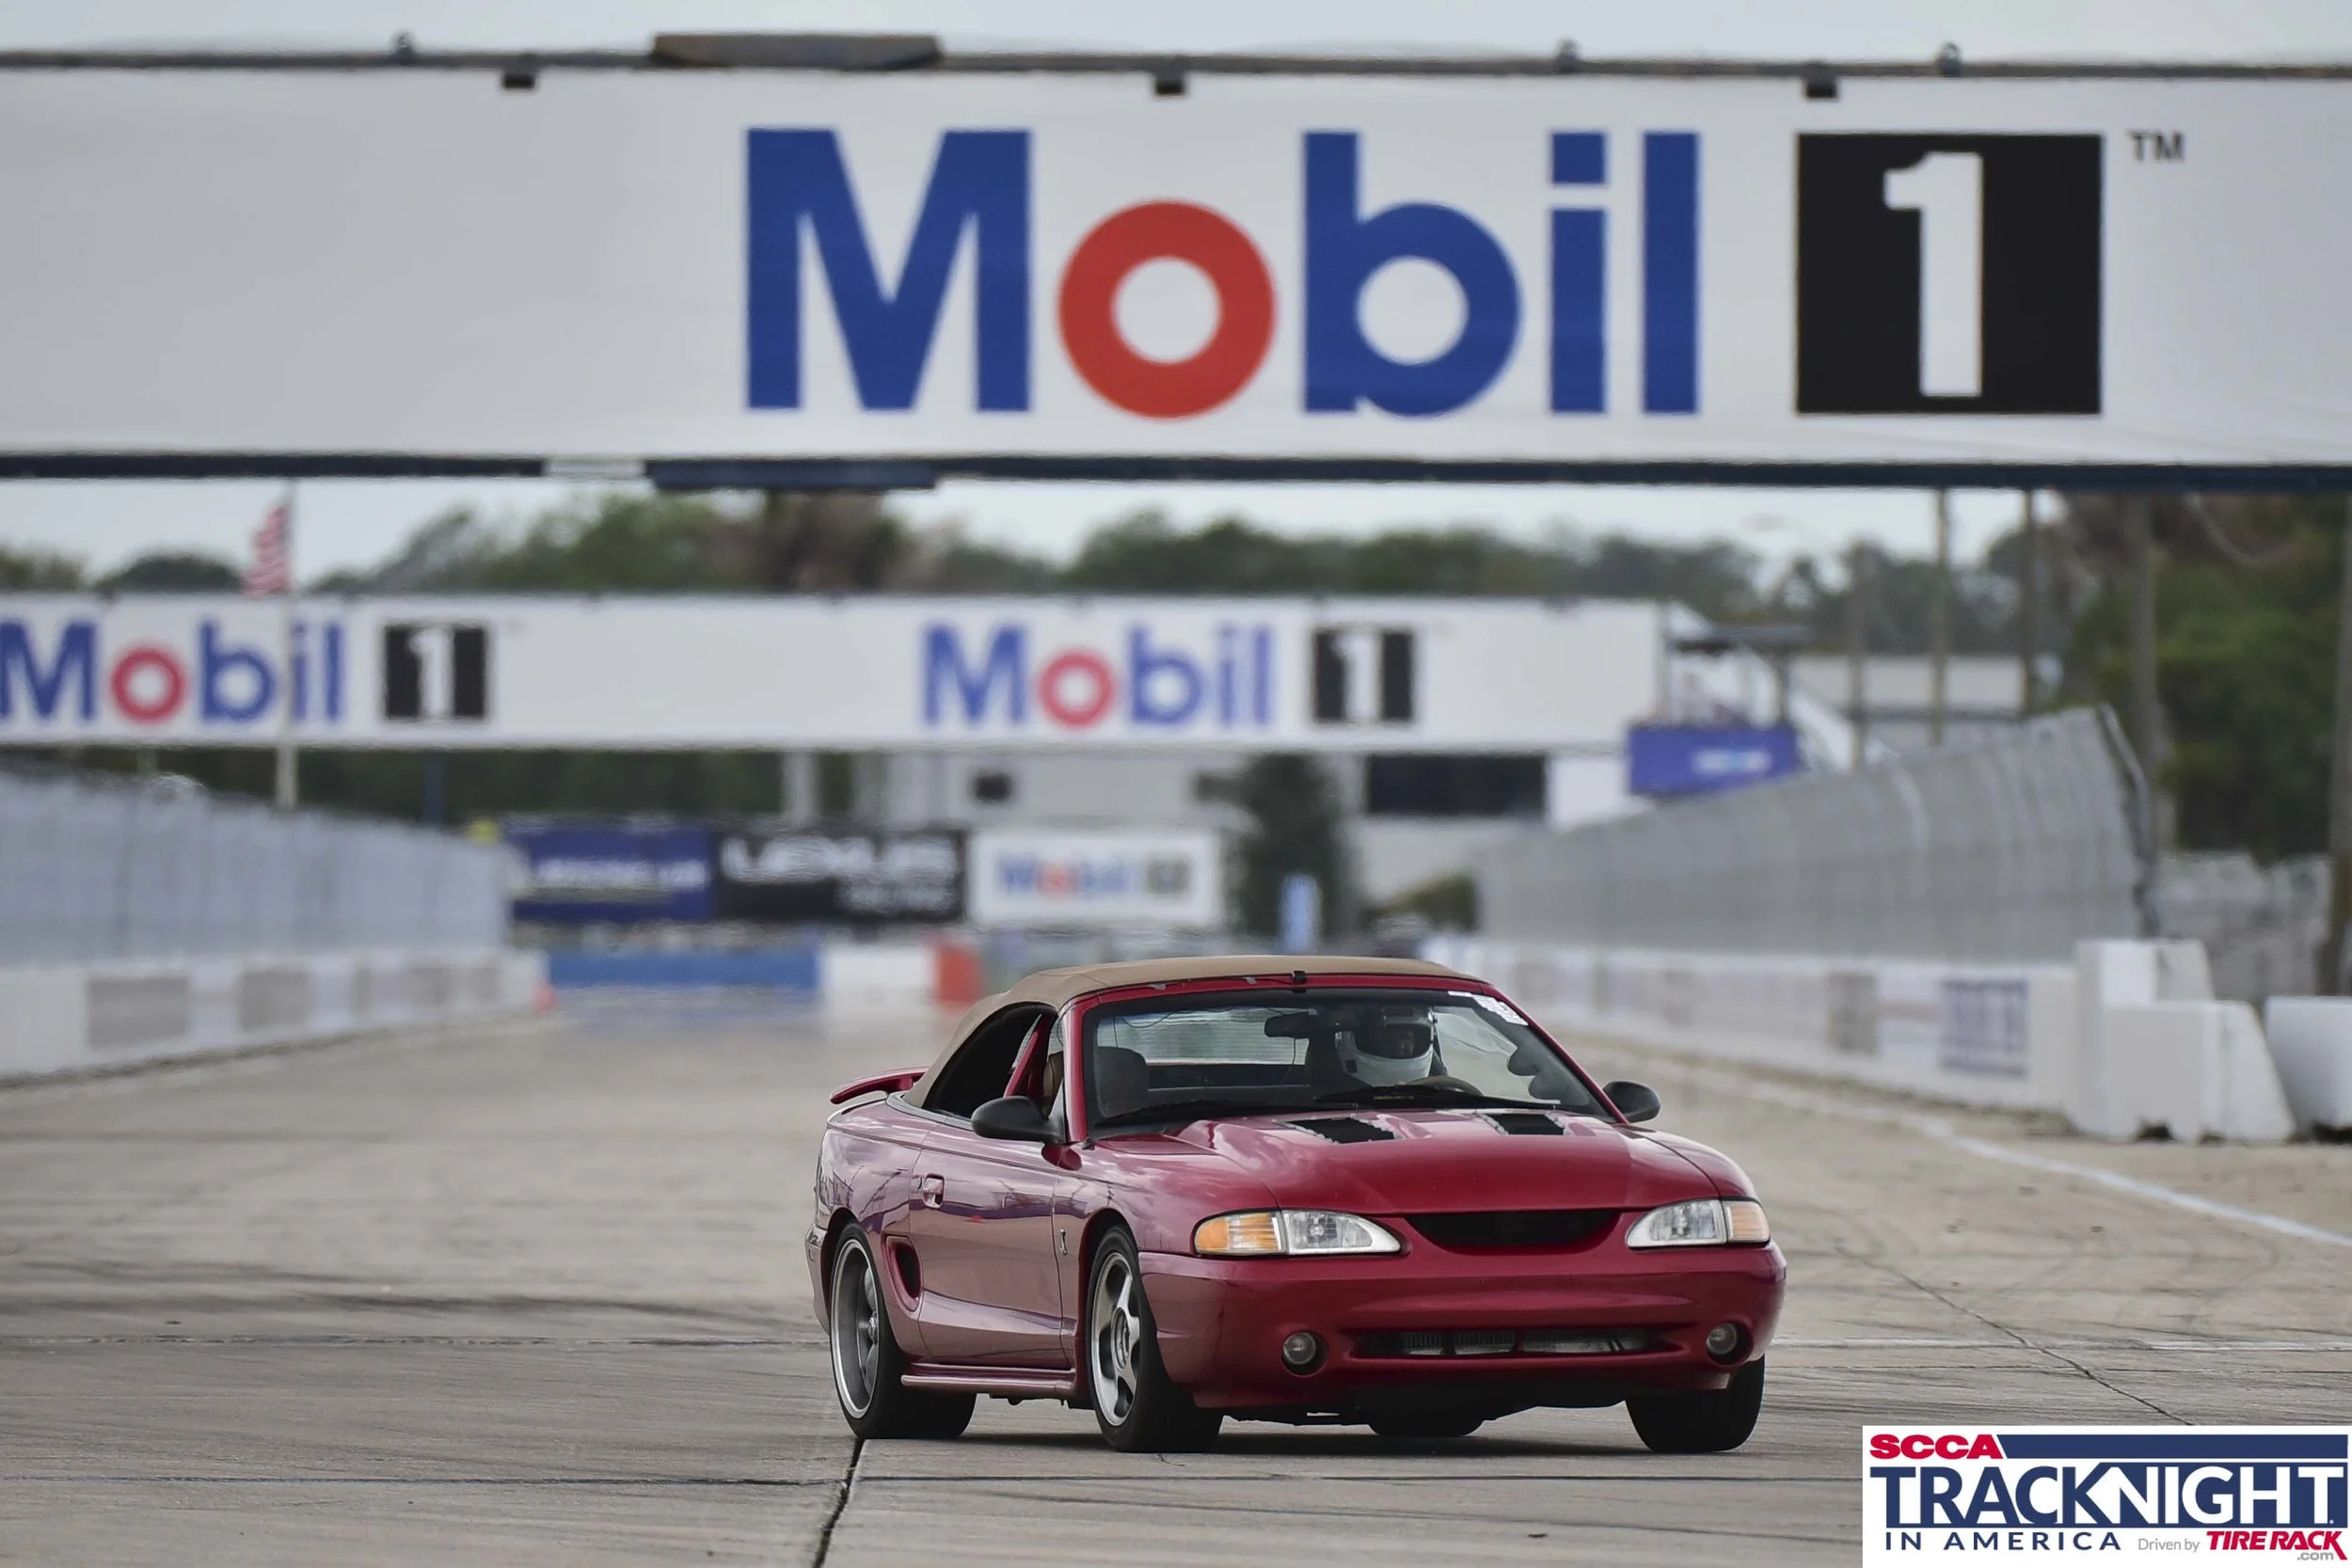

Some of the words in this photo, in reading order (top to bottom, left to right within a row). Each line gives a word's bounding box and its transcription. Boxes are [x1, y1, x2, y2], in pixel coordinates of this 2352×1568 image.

[745, 128, 1701, 420] Mobil
[1883, 151, 1982, 397] 1
[2130, 132, 2185, 162] TM
[0, 622, 342, 723] Mobil
[408, 627, 453, 719] 1
[923, 626, 1272, 728] Mobil
[1337, 629, 1384, 722] 1
